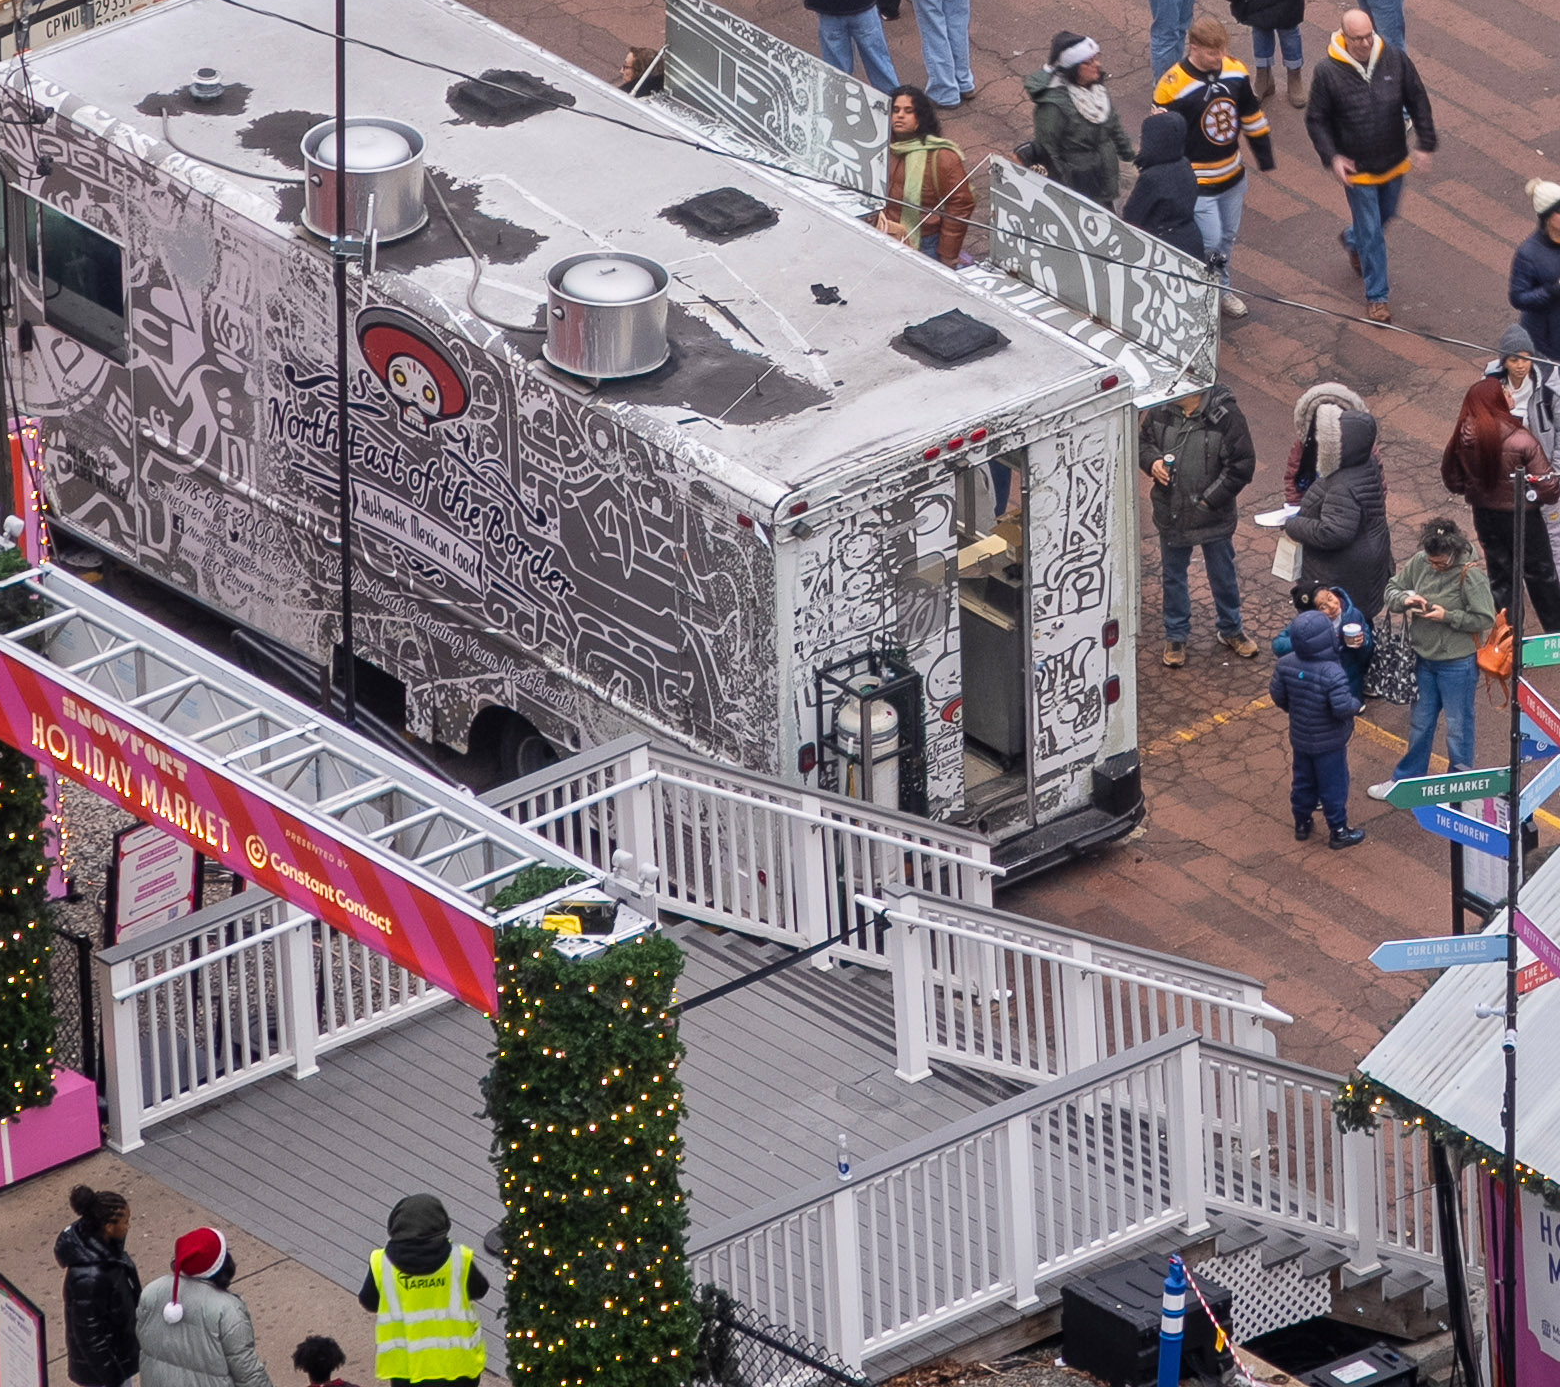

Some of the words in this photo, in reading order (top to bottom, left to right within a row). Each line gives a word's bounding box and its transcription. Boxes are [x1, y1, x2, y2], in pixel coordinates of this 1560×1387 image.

[45, 16, 81, 39] CPWU
[268, 396, 341, 455] North
[347, 422, 405, 484] East
[174, 472, 277, 545] 978-675-3000
[360, 490, 408, 534] Authentic
[410, 514, 451, 560] Mexican
[452, 542, 477, 579] food
[407, 456, 439, 509] of
[439, 474, 481, 529] the
[485, 504, 577, 598] Border
[61, 694, 189, 783] SNOWPORT
[30, 712, 133, 800] HOLIDAY
[140, 777, 232, 855] MARKET
[1421, 782, 1447, 798] TREE
[1448, 777, 1491, 795] MARKET
[1435, 812, 1451, 829] THE
[1453, 819, 1490, 845] CURRENT
[270, 851, 336, 906] Constant
[334, 888, 394, 936] Contact
[1406, 943, 1450, 957] CURLING
[1454, 939, 1487, 953] LANES
